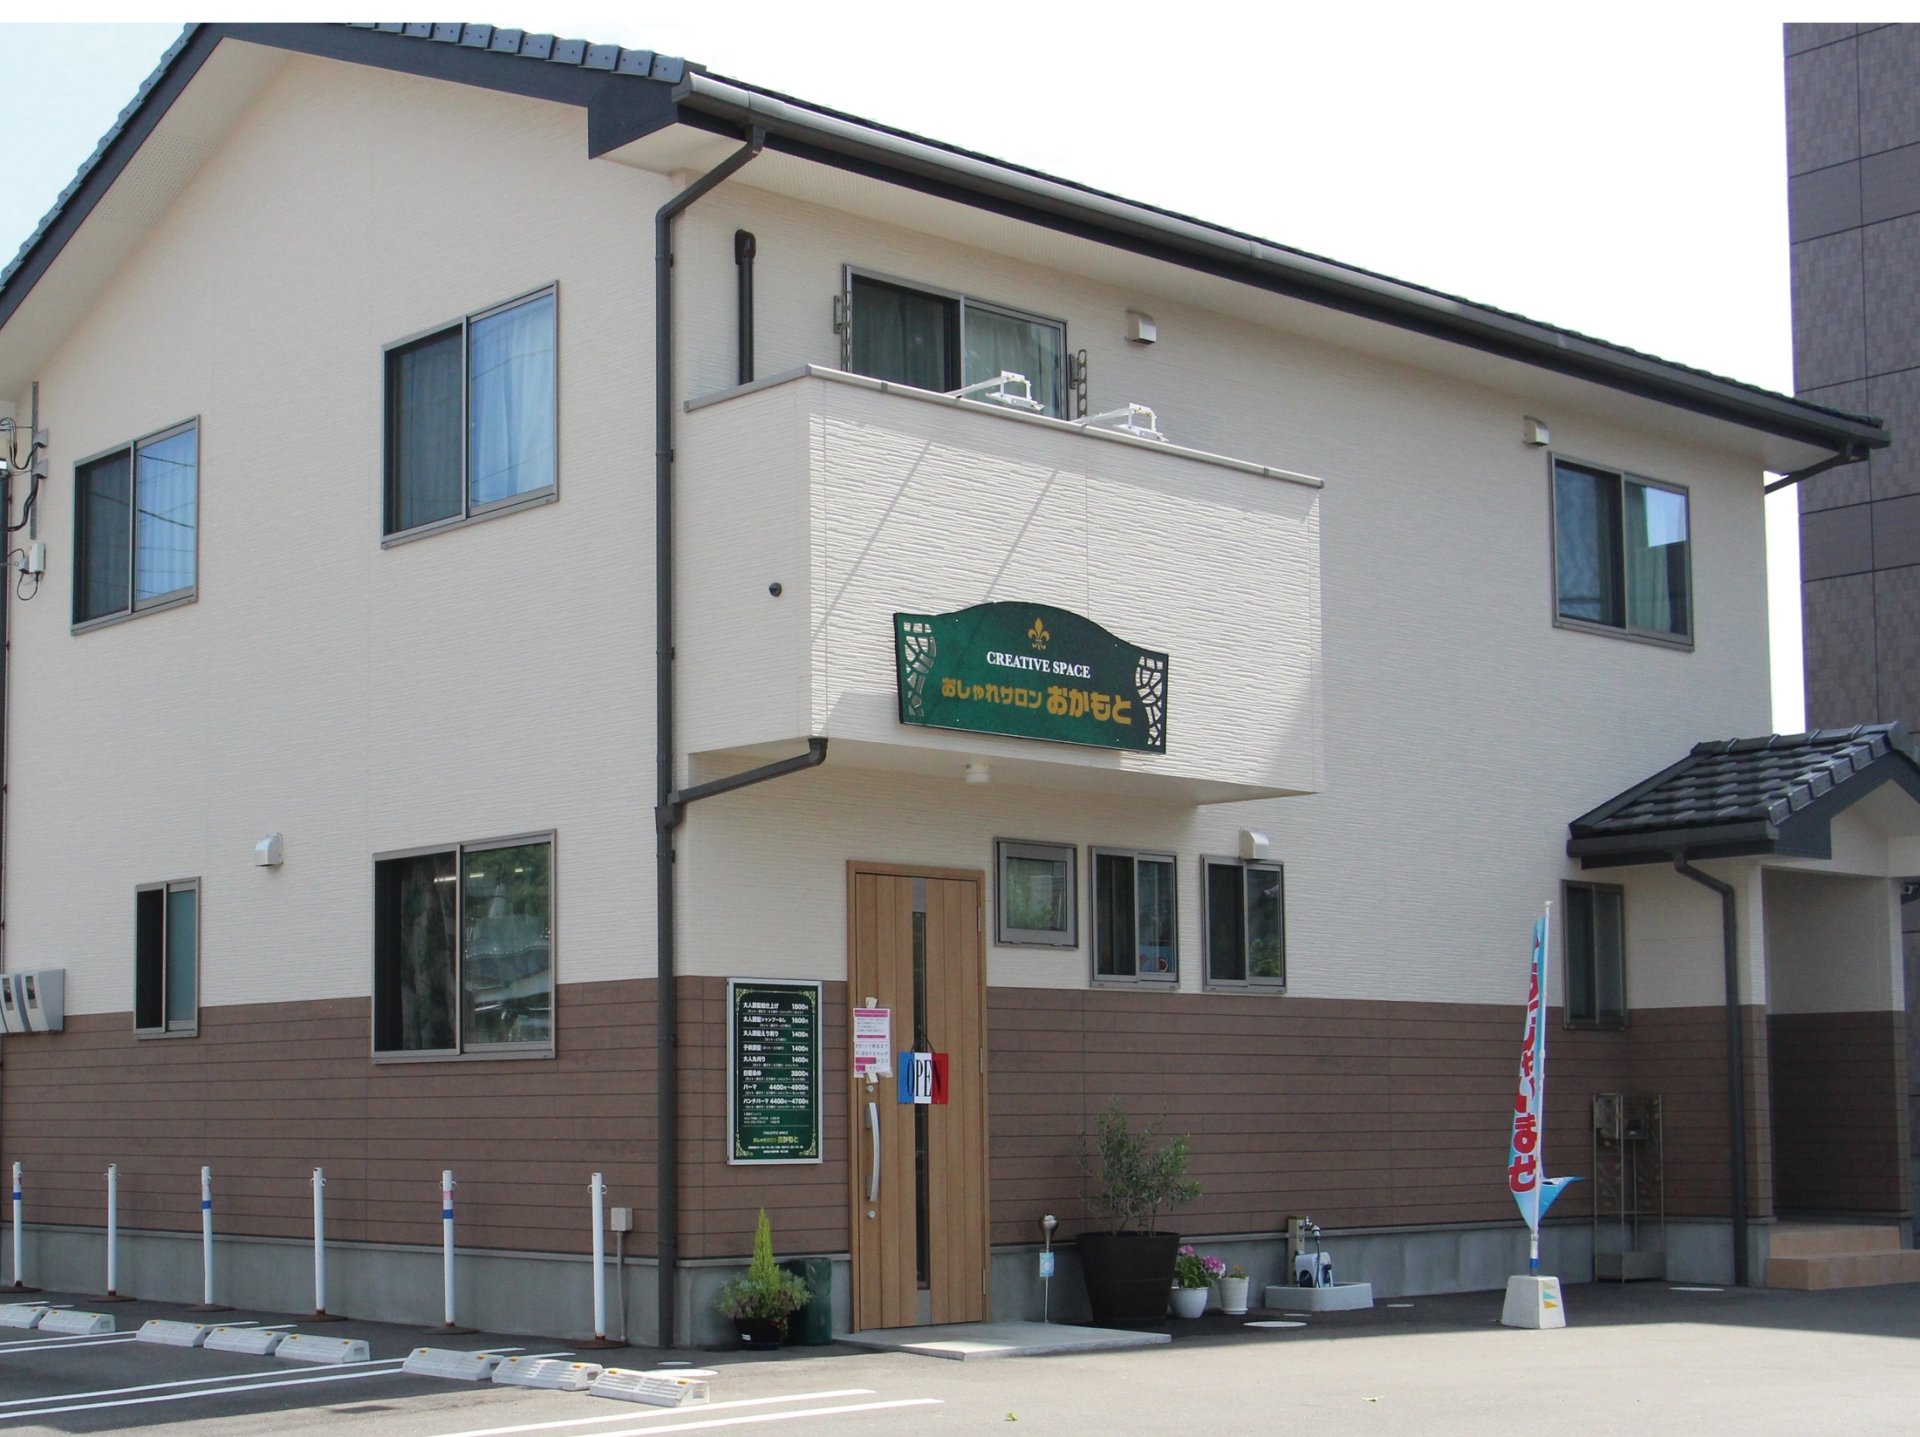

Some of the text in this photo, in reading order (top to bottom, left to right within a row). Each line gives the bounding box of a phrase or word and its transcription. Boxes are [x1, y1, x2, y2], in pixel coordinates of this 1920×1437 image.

[986, 651, 1091, 679] CREATIVE SPACE
[941, 677, 1132, 725] おしゃれサロン おかもと
[906, 1059, 941, 1097] OPEN
